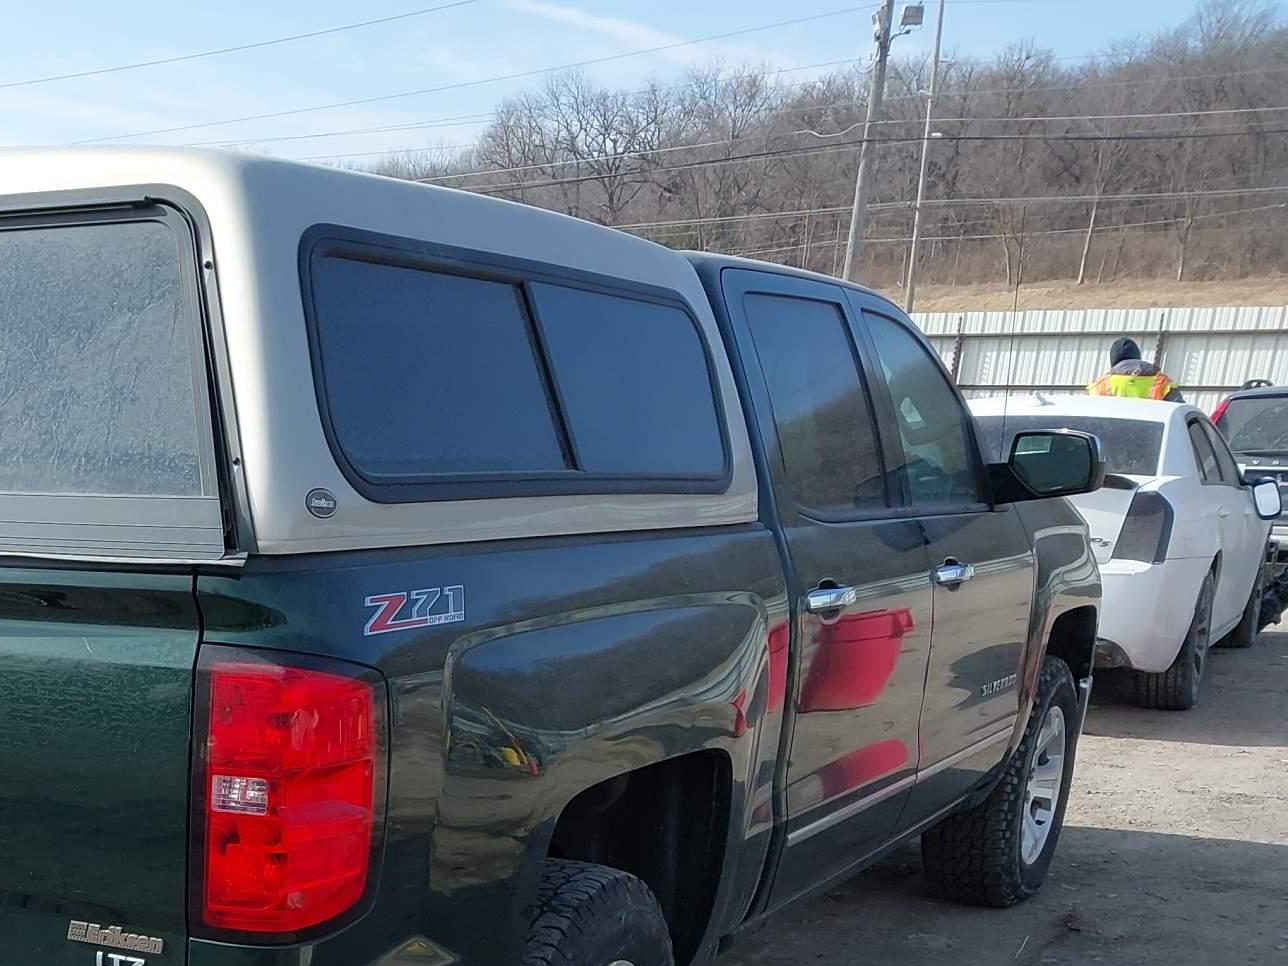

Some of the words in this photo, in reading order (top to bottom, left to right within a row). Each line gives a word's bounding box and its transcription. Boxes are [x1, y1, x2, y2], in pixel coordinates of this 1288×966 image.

[364, 585, 465, 636] Z71
[429, 616, 443, 624] OFF
[444, 613, 464, 622] ROAD
